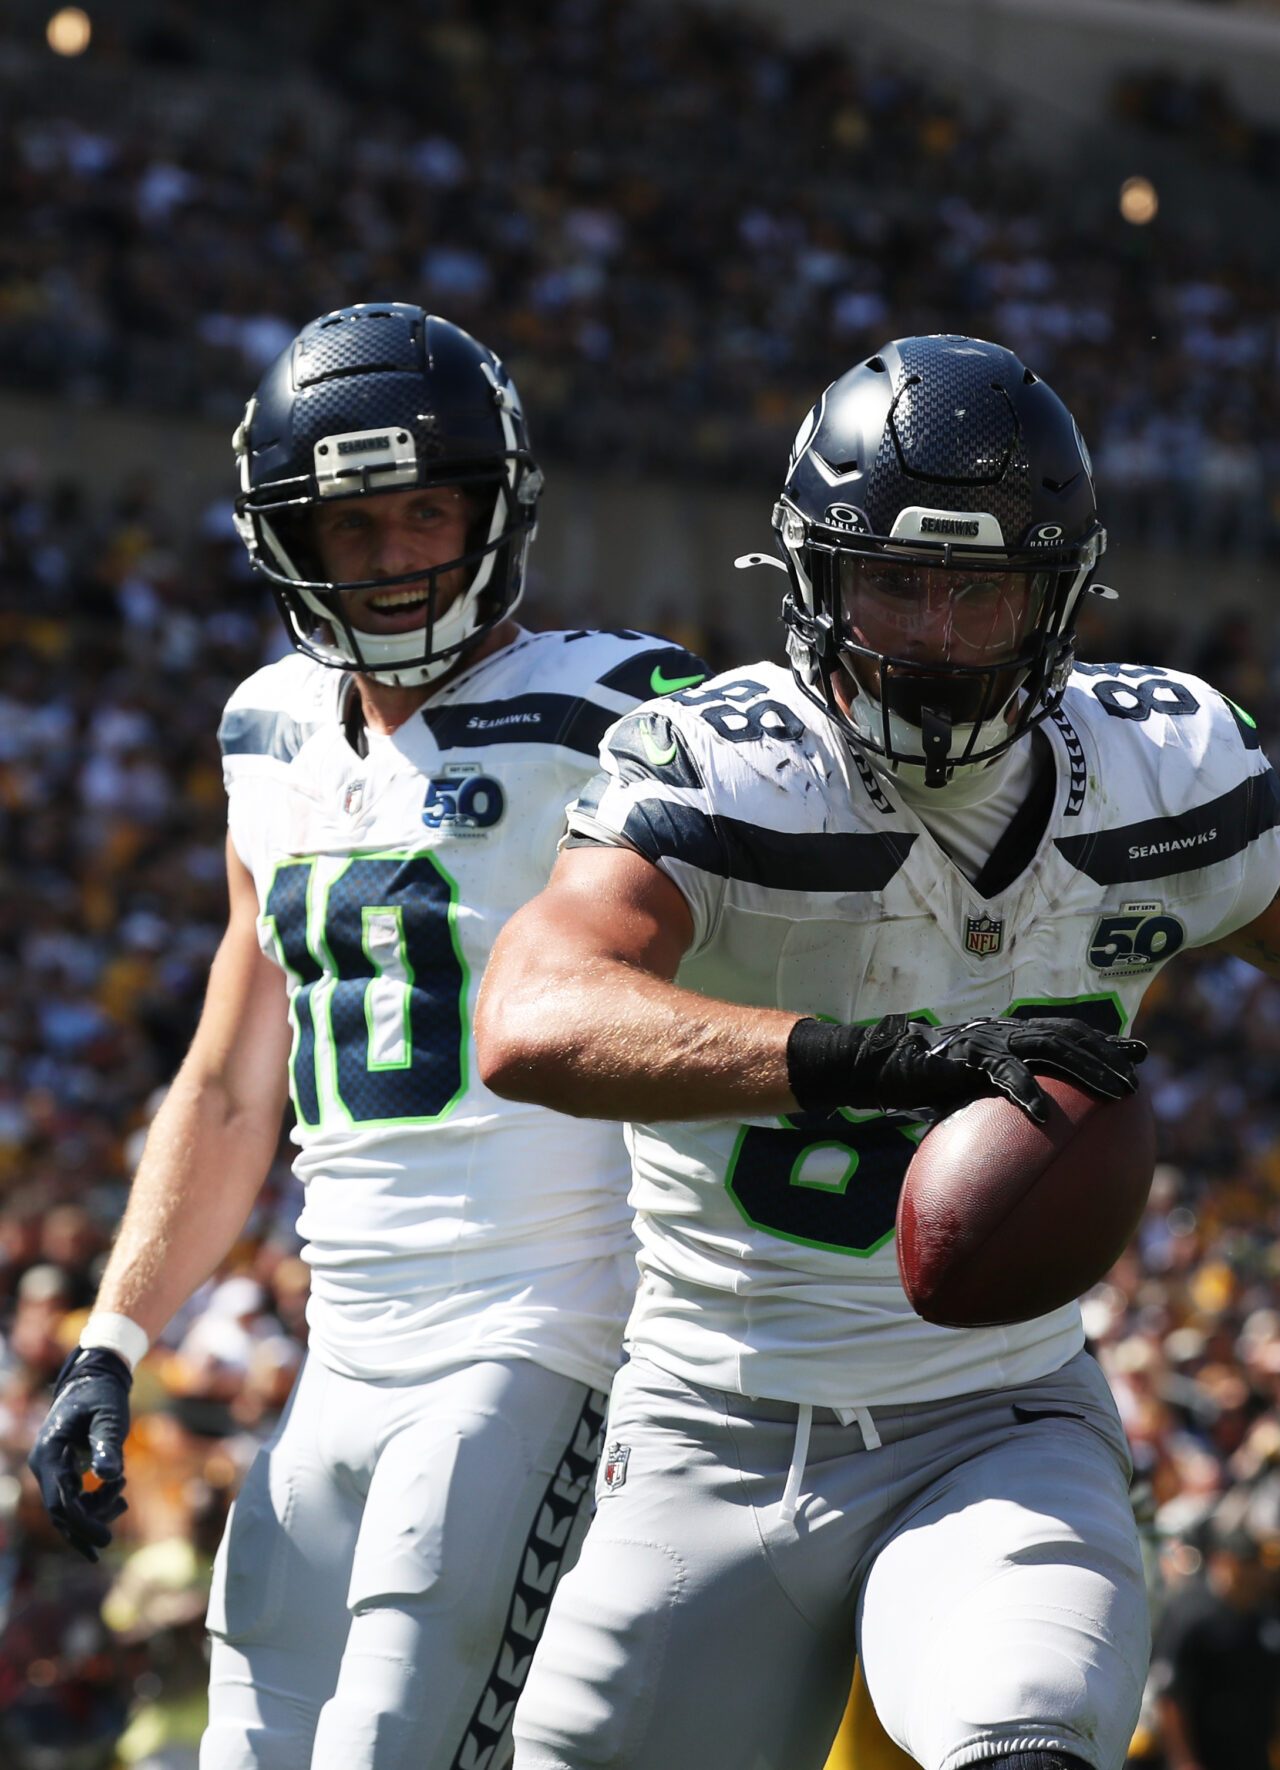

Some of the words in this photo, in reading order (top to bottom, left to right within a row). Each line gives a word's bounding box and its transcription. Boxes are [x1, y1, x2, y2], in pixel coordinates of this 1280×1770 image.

[825, 517, 864, 533] OAKLEY
[920, 516, 979, 537] SEAHAWKS
[466, 713, 542, 729] SEAHAWKS
[422, 776, 504, 829] 50
[1128, 828, 1218, 859] SEAHAWKS
[969, 932, 997, 952] NFL
[1089, 916, 1185, 968] 50
[262, 850, 471, 1132] 10
